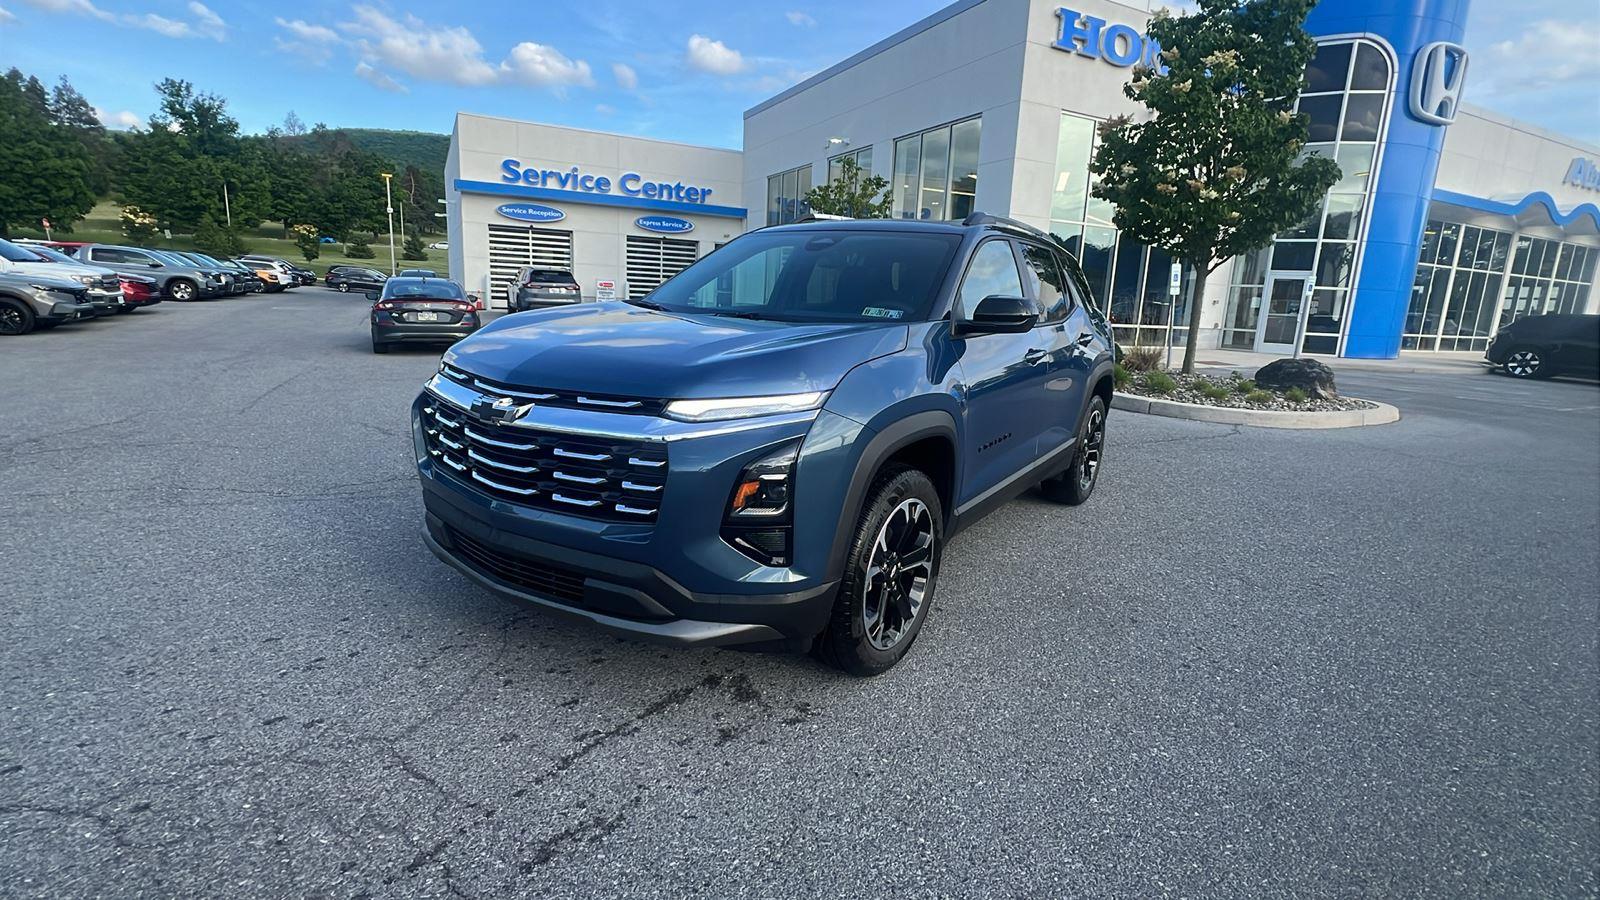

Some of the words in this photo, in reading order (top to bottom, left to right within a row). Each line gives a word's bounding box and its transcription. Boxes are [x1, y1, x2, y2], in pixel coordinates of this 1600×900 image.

[1052, 7, 1170, 78] HON
[501, 158, 611, 193] Service
[619, 173, 713, 204] Center
[501, 206, 527, 214] Service
[528, 208, 562, 217] Reception
[639, 219, 661, 227] Express
